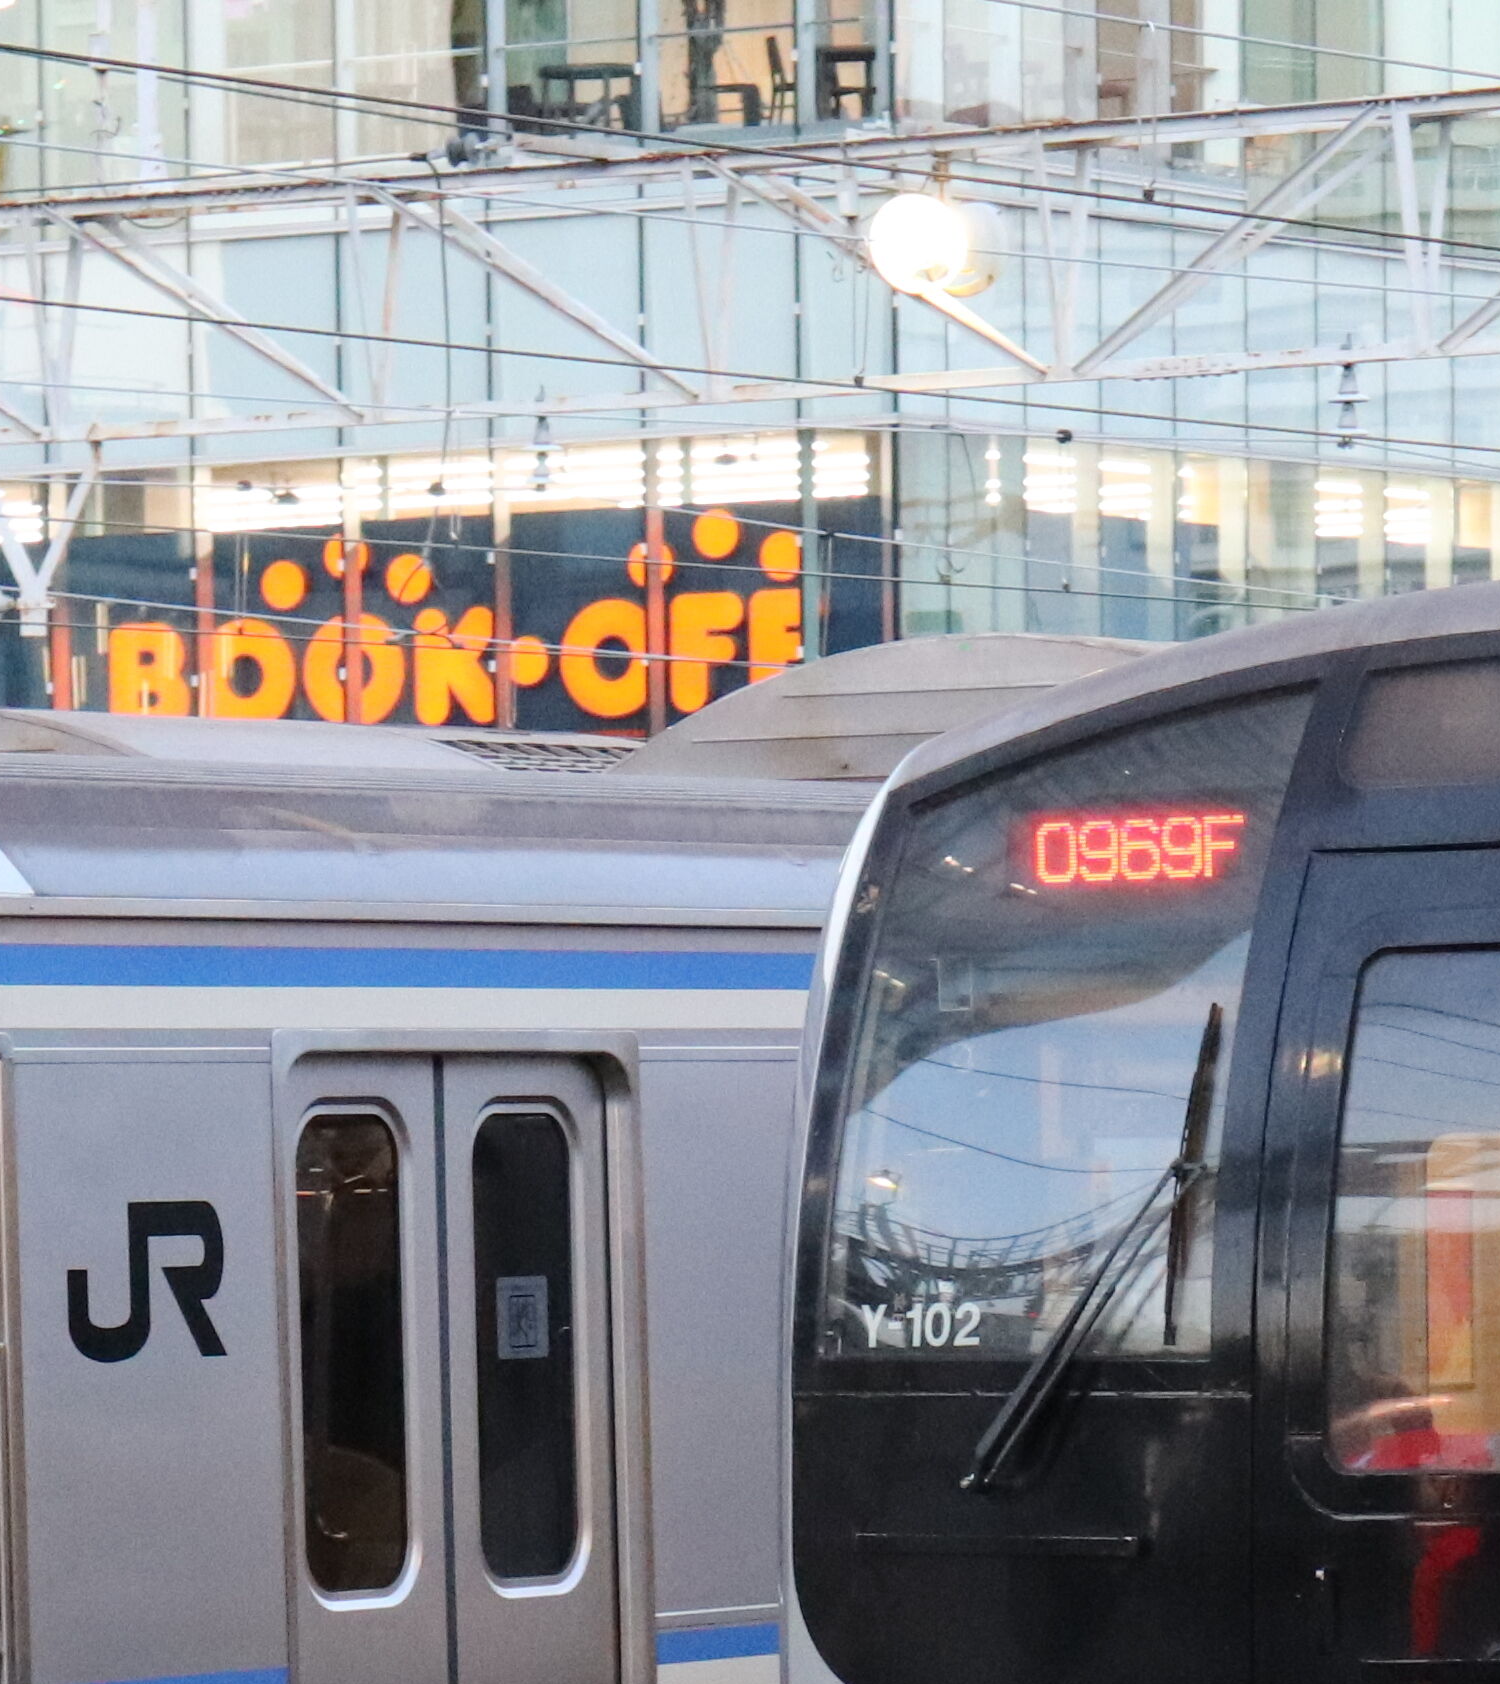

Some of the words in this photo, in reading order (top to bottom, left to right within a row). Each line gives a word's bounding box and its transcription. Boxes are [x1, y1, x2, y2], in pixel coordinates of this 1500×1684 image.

[1036, 815, 1244, 883] 0969F
[67, 1200, 228, 1363] JR
[861, 1302, 981, 1348] Y-102
